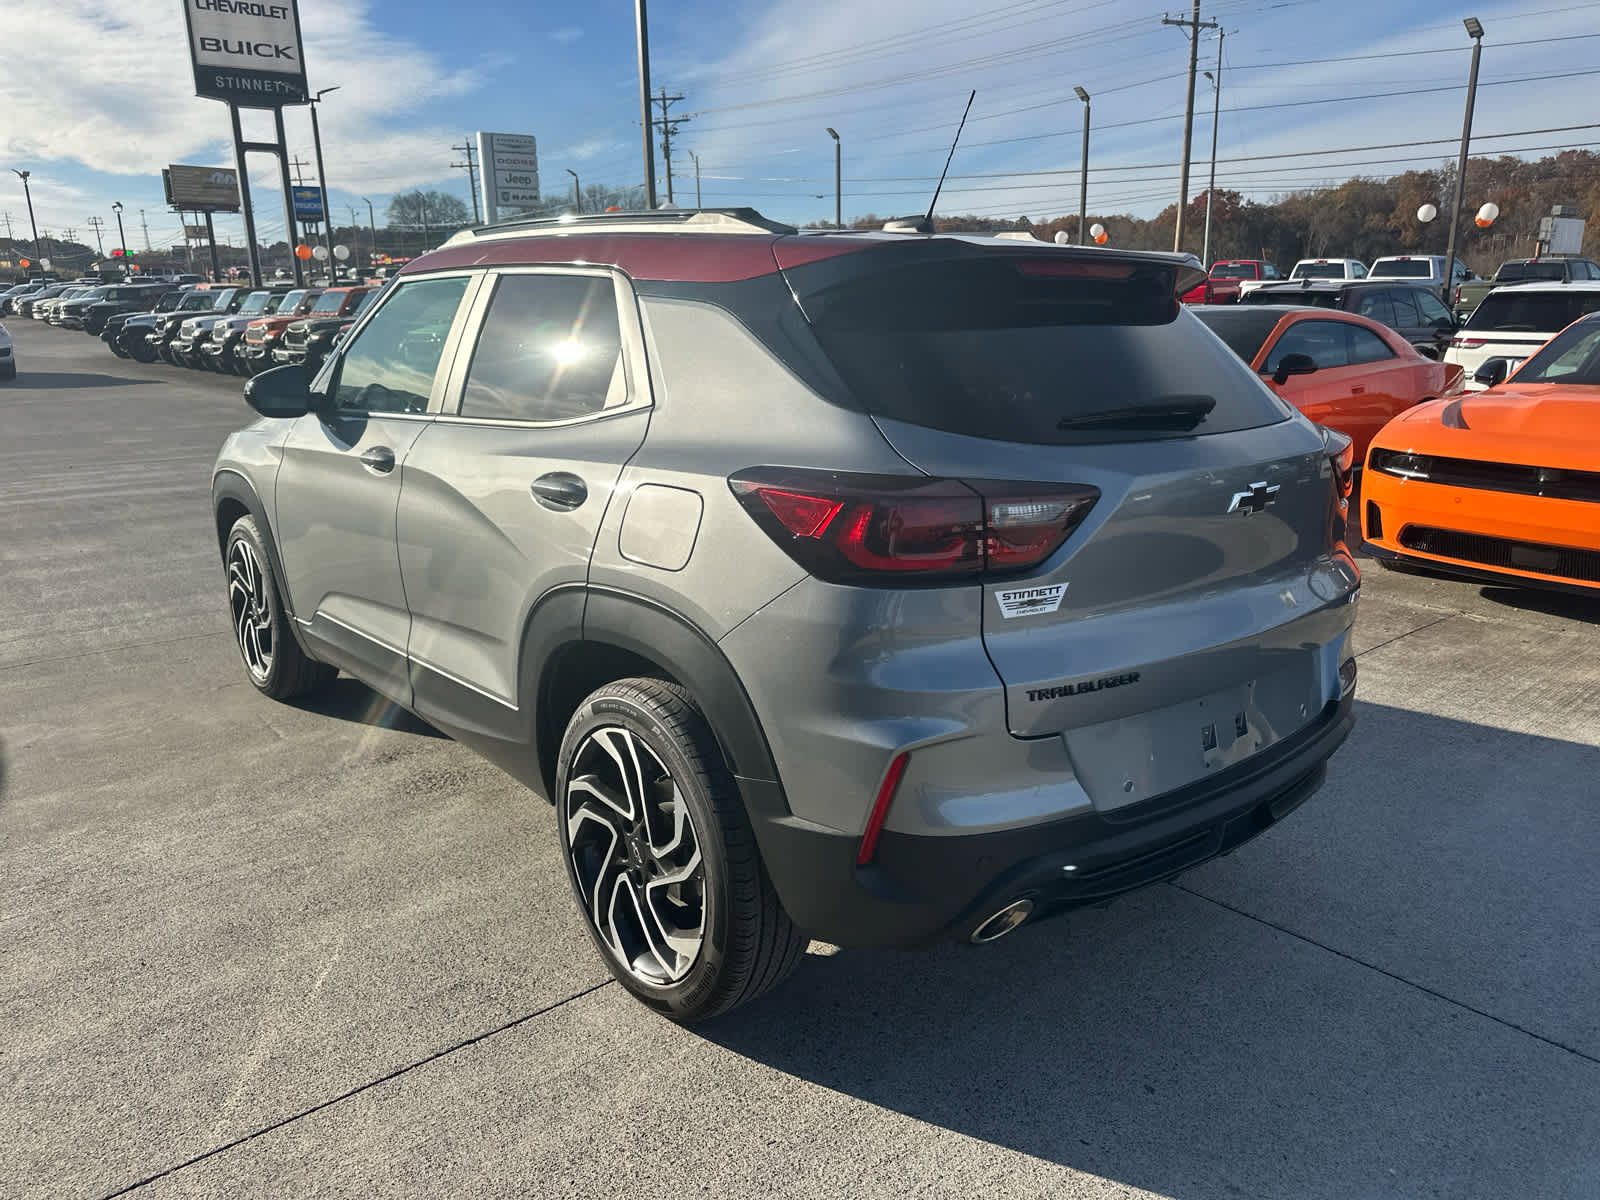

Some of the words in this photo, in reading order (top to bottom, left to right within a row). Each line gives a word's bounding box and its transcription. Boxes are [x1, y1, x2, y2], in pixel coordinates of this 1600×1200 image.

[195, 0, 288, 20] CHEVROLET
[199, 37, 296, 60] BUICK
[216, 75, 290, 93] STINNETT
[504, 172, 532, 185] Jeep
[1002, 586, 1062, 601] STINNETT
[1026, 671, 1141, 702] TRAILBLAZER
